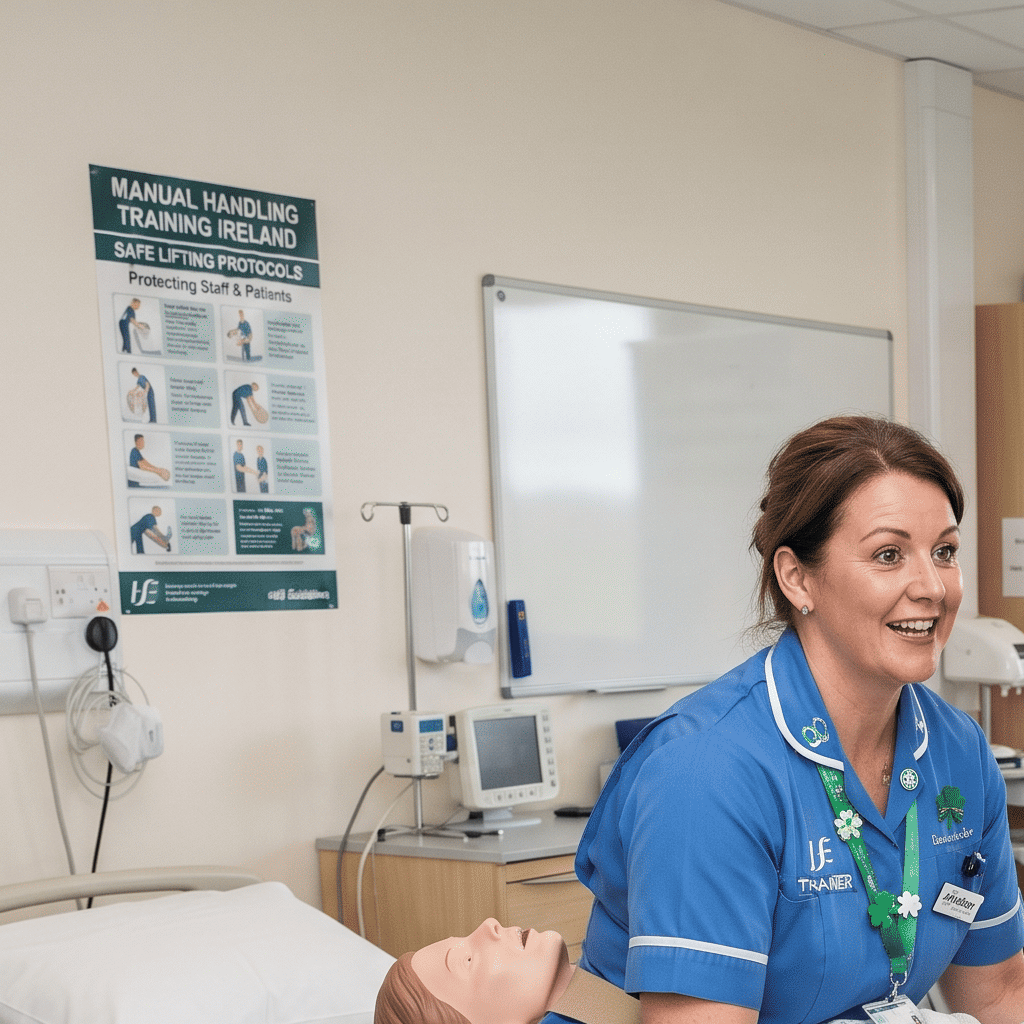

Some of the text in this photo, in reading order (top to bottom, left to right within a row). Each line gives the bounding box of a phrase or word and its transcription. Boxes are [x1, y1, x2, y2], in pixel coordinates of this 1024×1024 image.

[111, 176, 299, 224] MANUAL HANDLING
[117, 204, 297, 249] TRAINING IRELAND
[114, 241, 303, 281] SAFE LIFTING PROTOCOLS
[129, 271, 197, 295] Protecting
[201, 280, 229, 295] Staff
[233, 283, 241, 297] &
